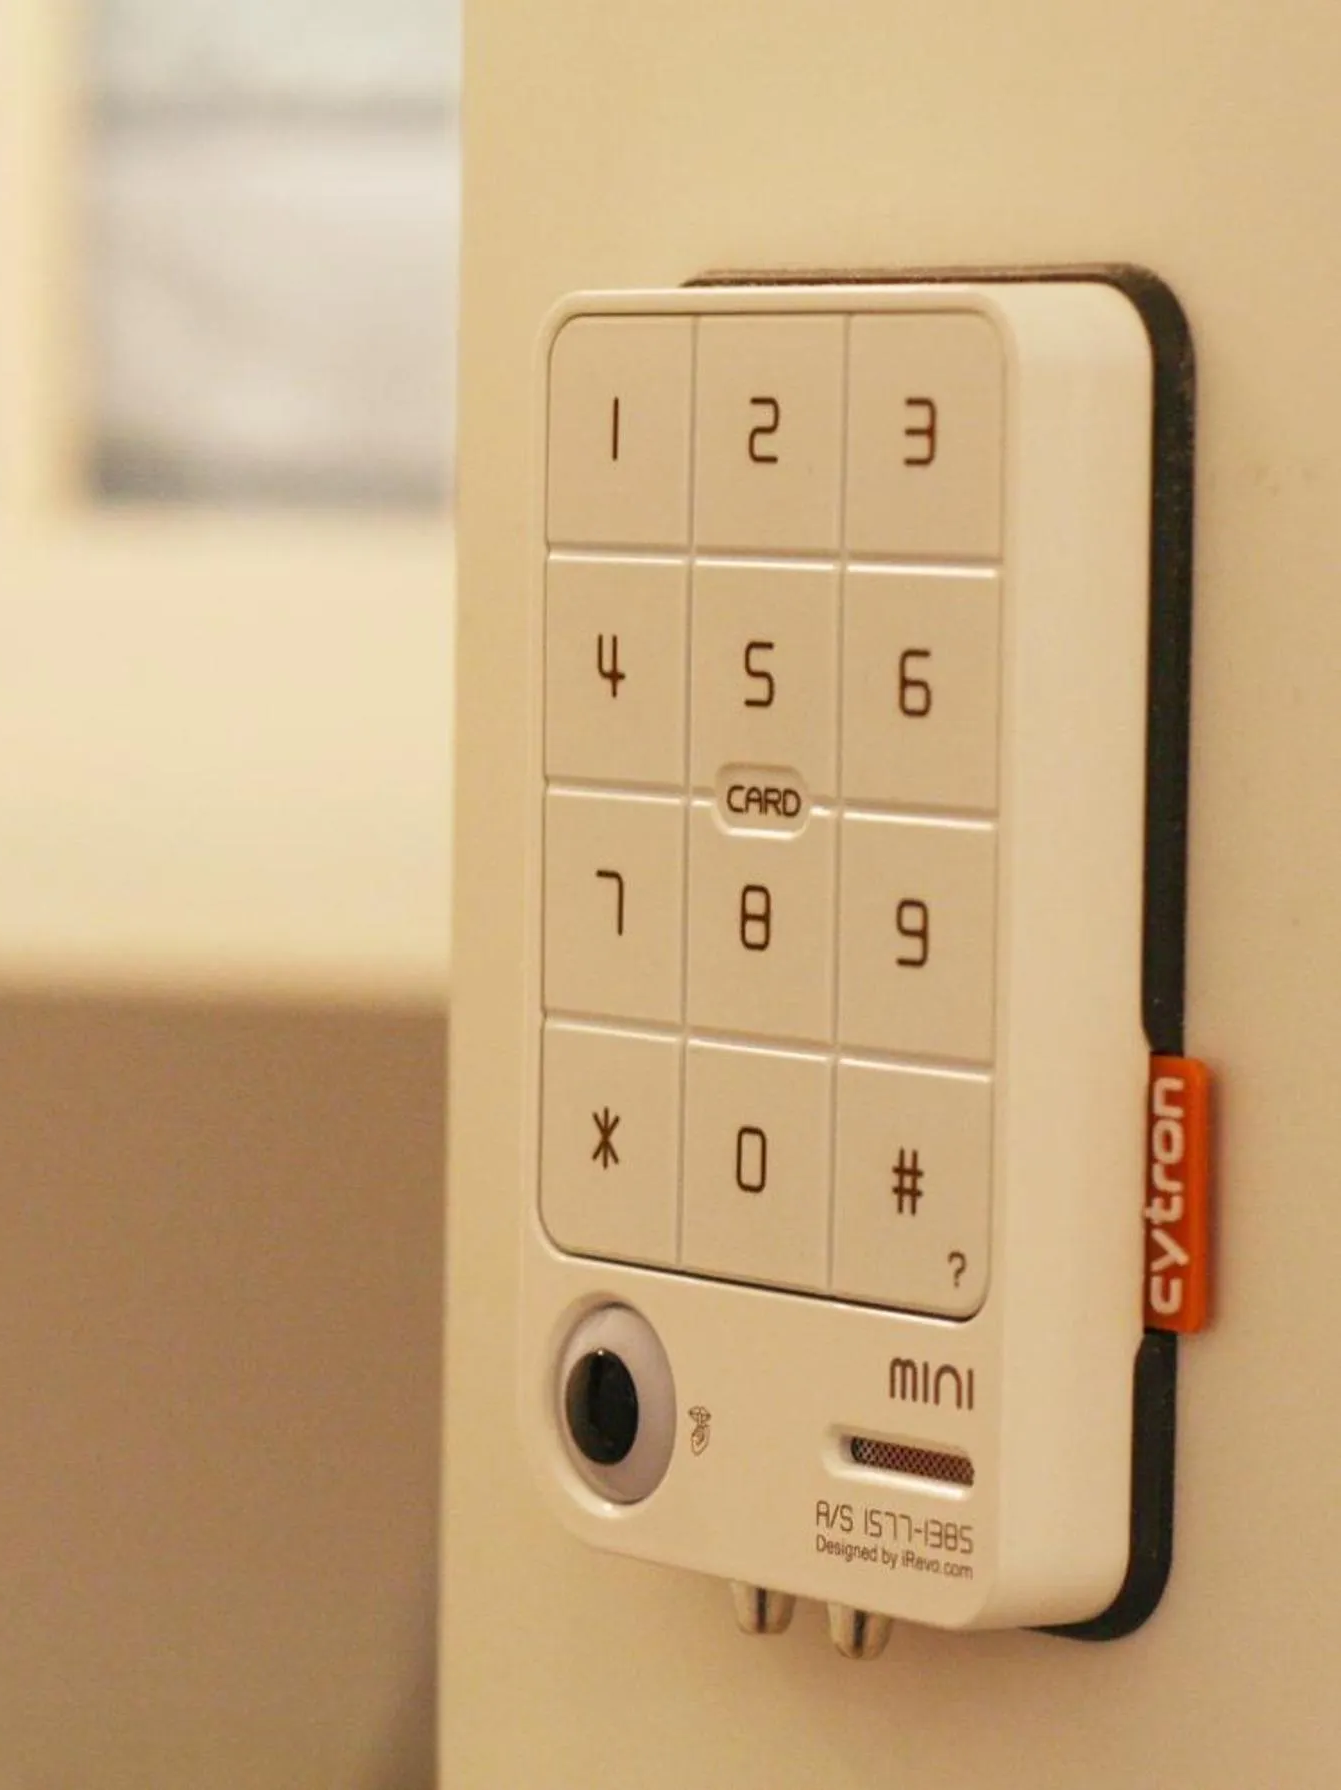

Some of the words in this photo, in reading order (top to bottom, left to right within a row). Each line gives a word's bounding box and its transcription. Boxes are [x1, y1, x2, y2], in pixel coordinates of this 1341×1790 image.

[611, 396, 620, 462] 1
[747, 396, 781, 465] 2
[903, 396, 938, 467] 3
[596, 633, 627, 699] 4
[743, 640, 776, 709] 5
[898, 648, 933, 719] 6
[725, 784, 802, 819] CARD
[595, 869, 625, 937] 7
[739, 883, 772, 952] 8
[895, 897, 930, 969] 9
[891, 1147, 925, 1217] #
[1143, 1076, 1190, 1315] cytron
[947, 1251, 967, 1287] ?
[816, 1500, 854, 1533] A/S
[864, 1509, 974, 1555] 1577-1385
[816, 1534, 878, 1563] Designed
[881, 1546, 899, 1570] by
[901, 1550, 974, 1580] iRevo.com
